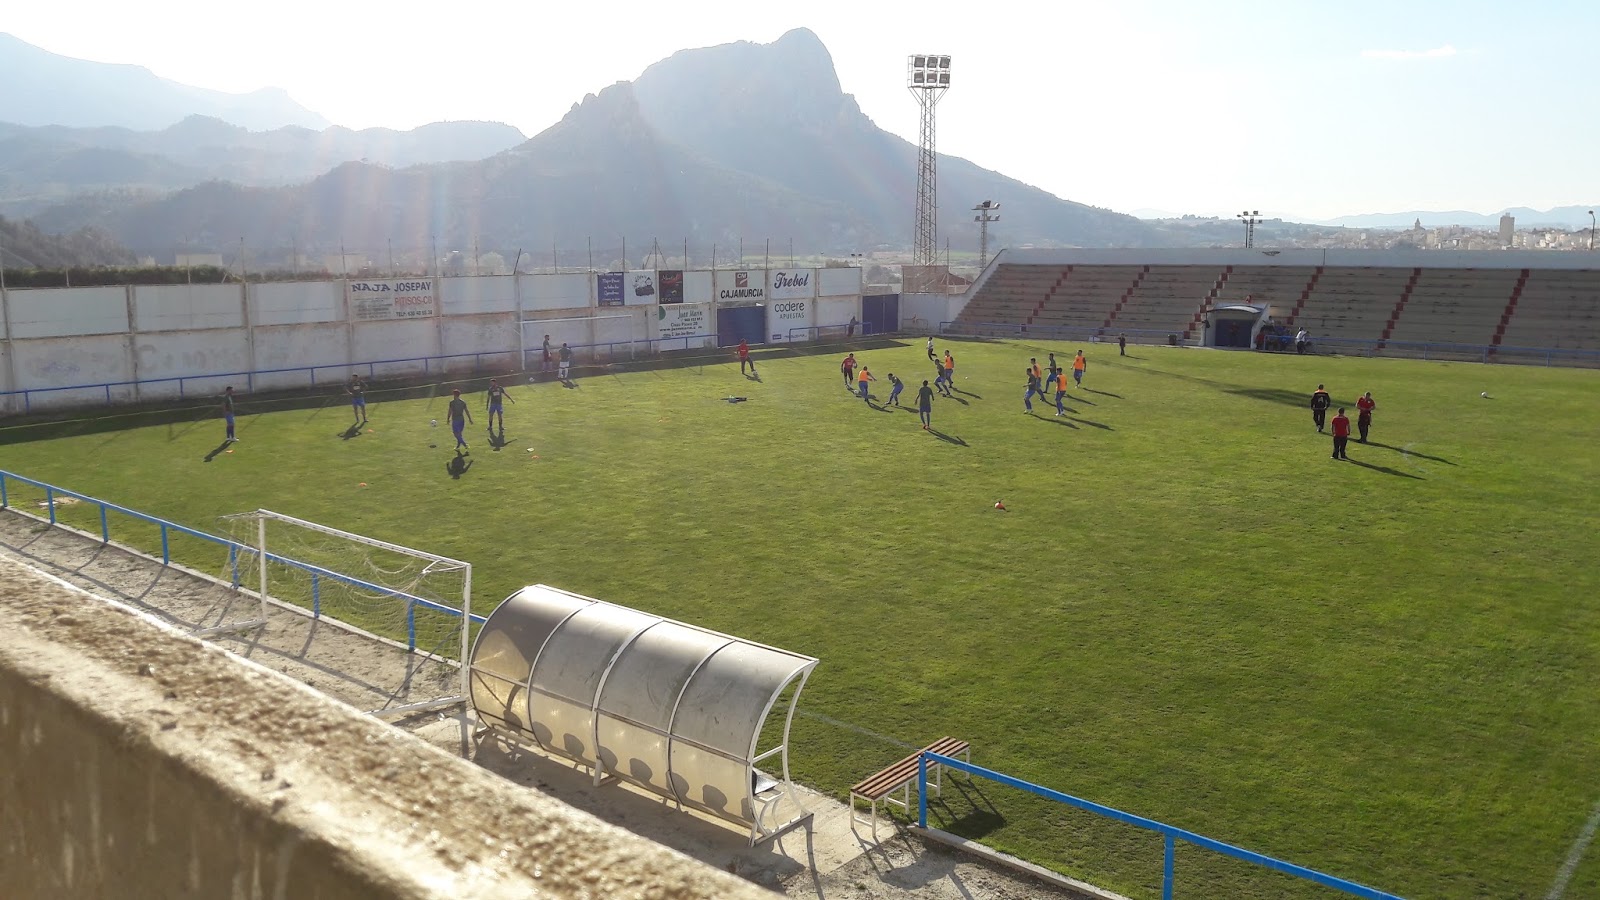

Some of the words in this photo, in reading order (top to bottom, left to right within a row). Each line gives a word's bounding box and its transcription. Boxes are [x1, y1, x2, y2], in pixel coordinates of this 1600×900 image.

[774, 272, 809, 289] Trebol
[352, 283, 391, 292] NAJA
[394, 282, 431, 292] JOSEPAY
[720, 288, 763, 299] CAJAMURCIA
[774, 301, 805, 312] codere
